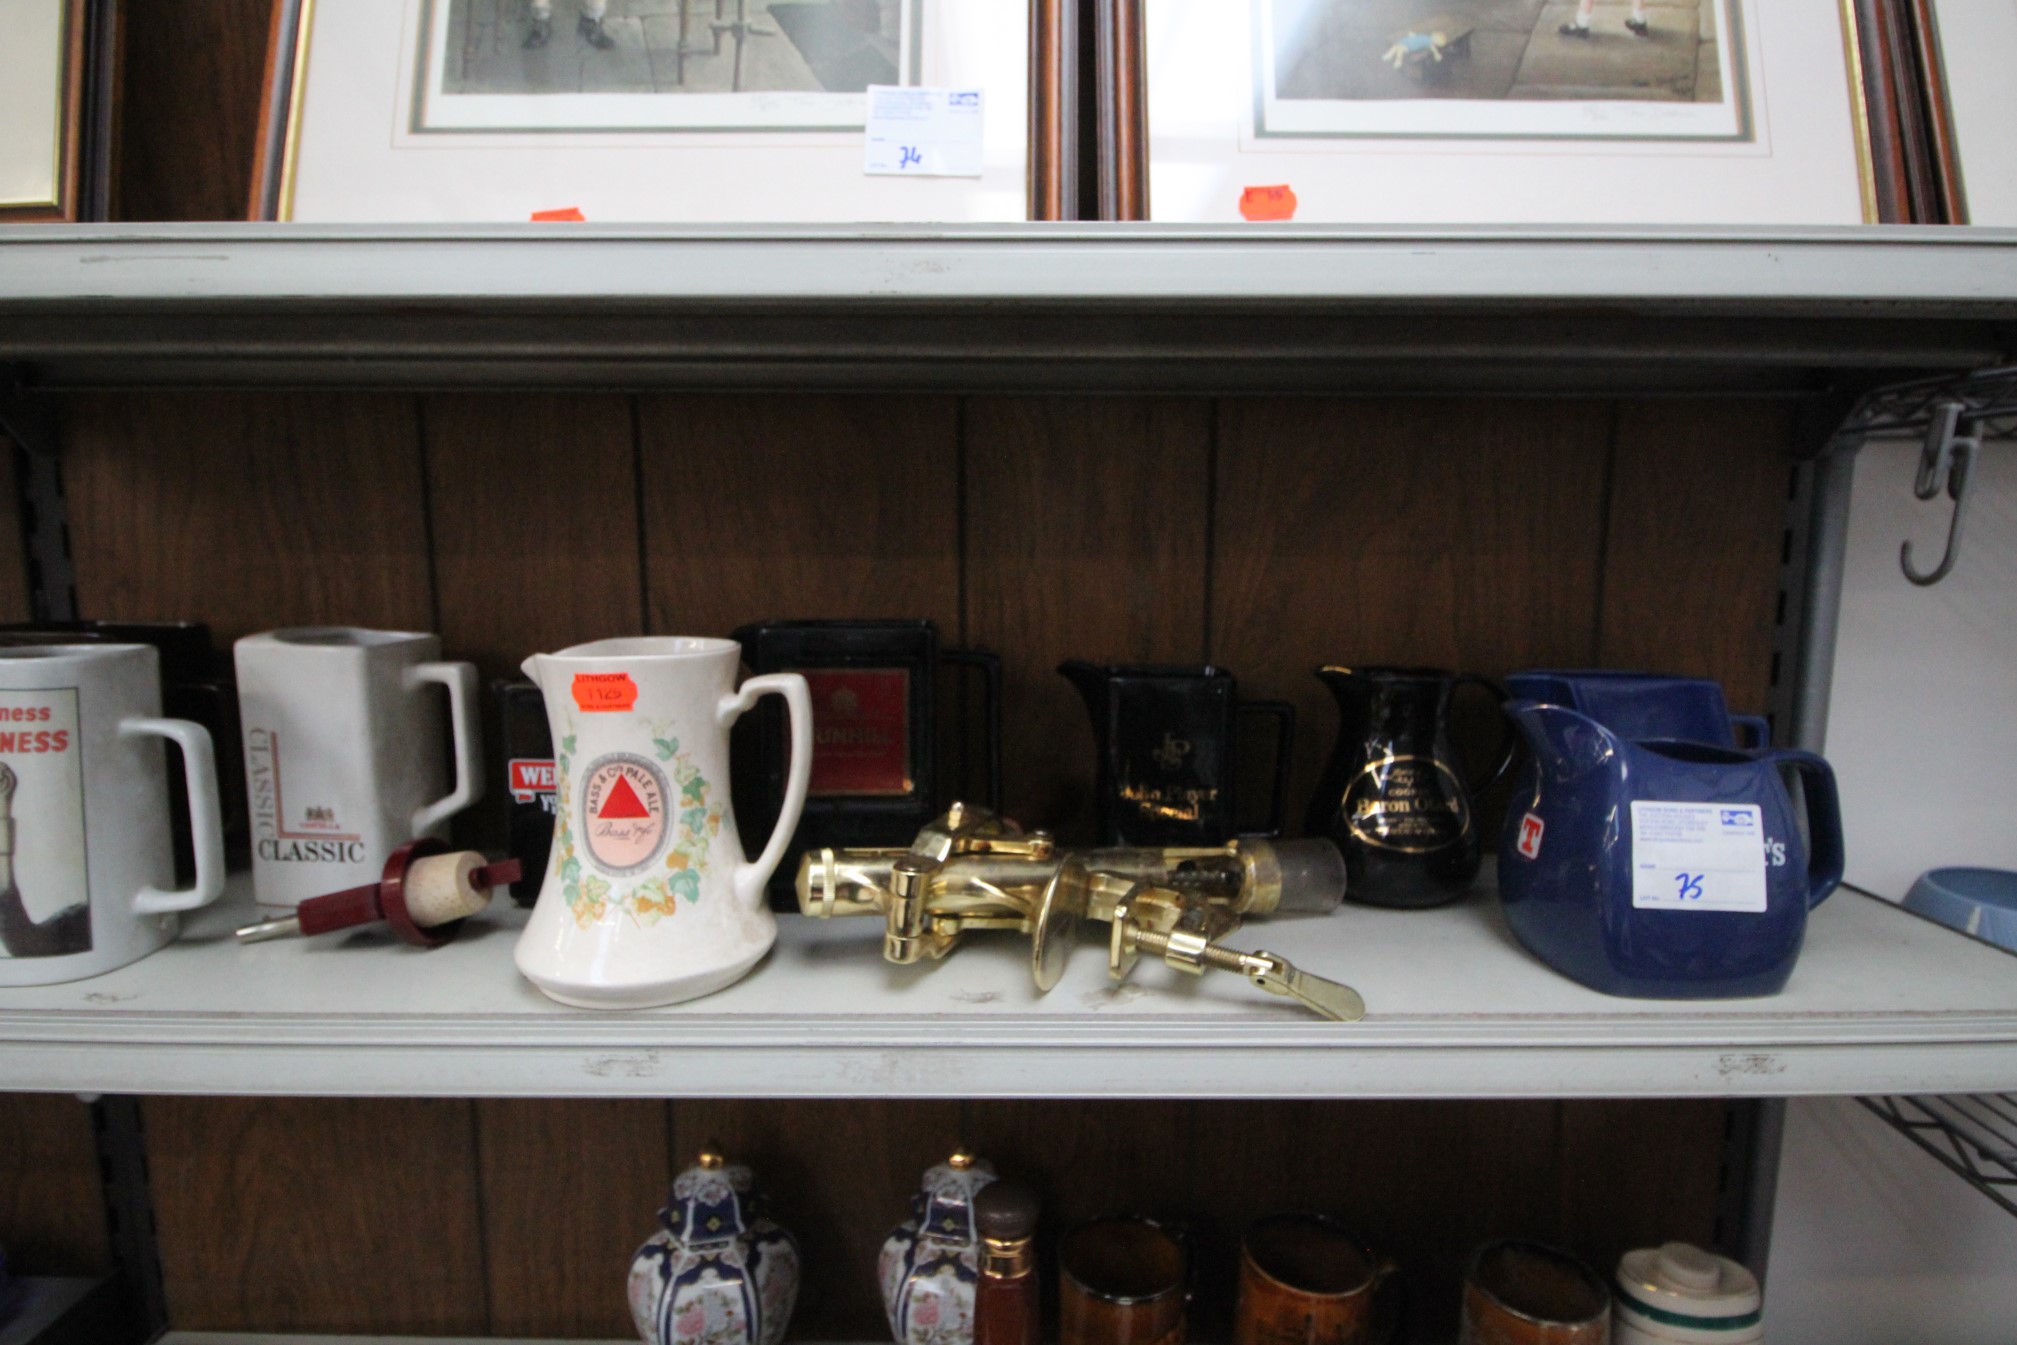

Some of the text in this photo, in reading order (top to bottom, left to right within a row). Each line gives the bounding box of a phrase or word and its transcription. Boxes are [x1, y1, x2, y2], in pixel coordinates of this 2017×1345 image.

[0, 729, 70, 754] NESS
[249, 728, 275, 838] CLASSIC
[589, 783, 602, 814] BASS
[626, 767, 653, 789] PALE
[647, 792, 660, 814] ALE
[258, 839, 365, 864] CLASSIC
[1522, 818, 1542, 854] T
[1675, 873, 1706, 899] 75
